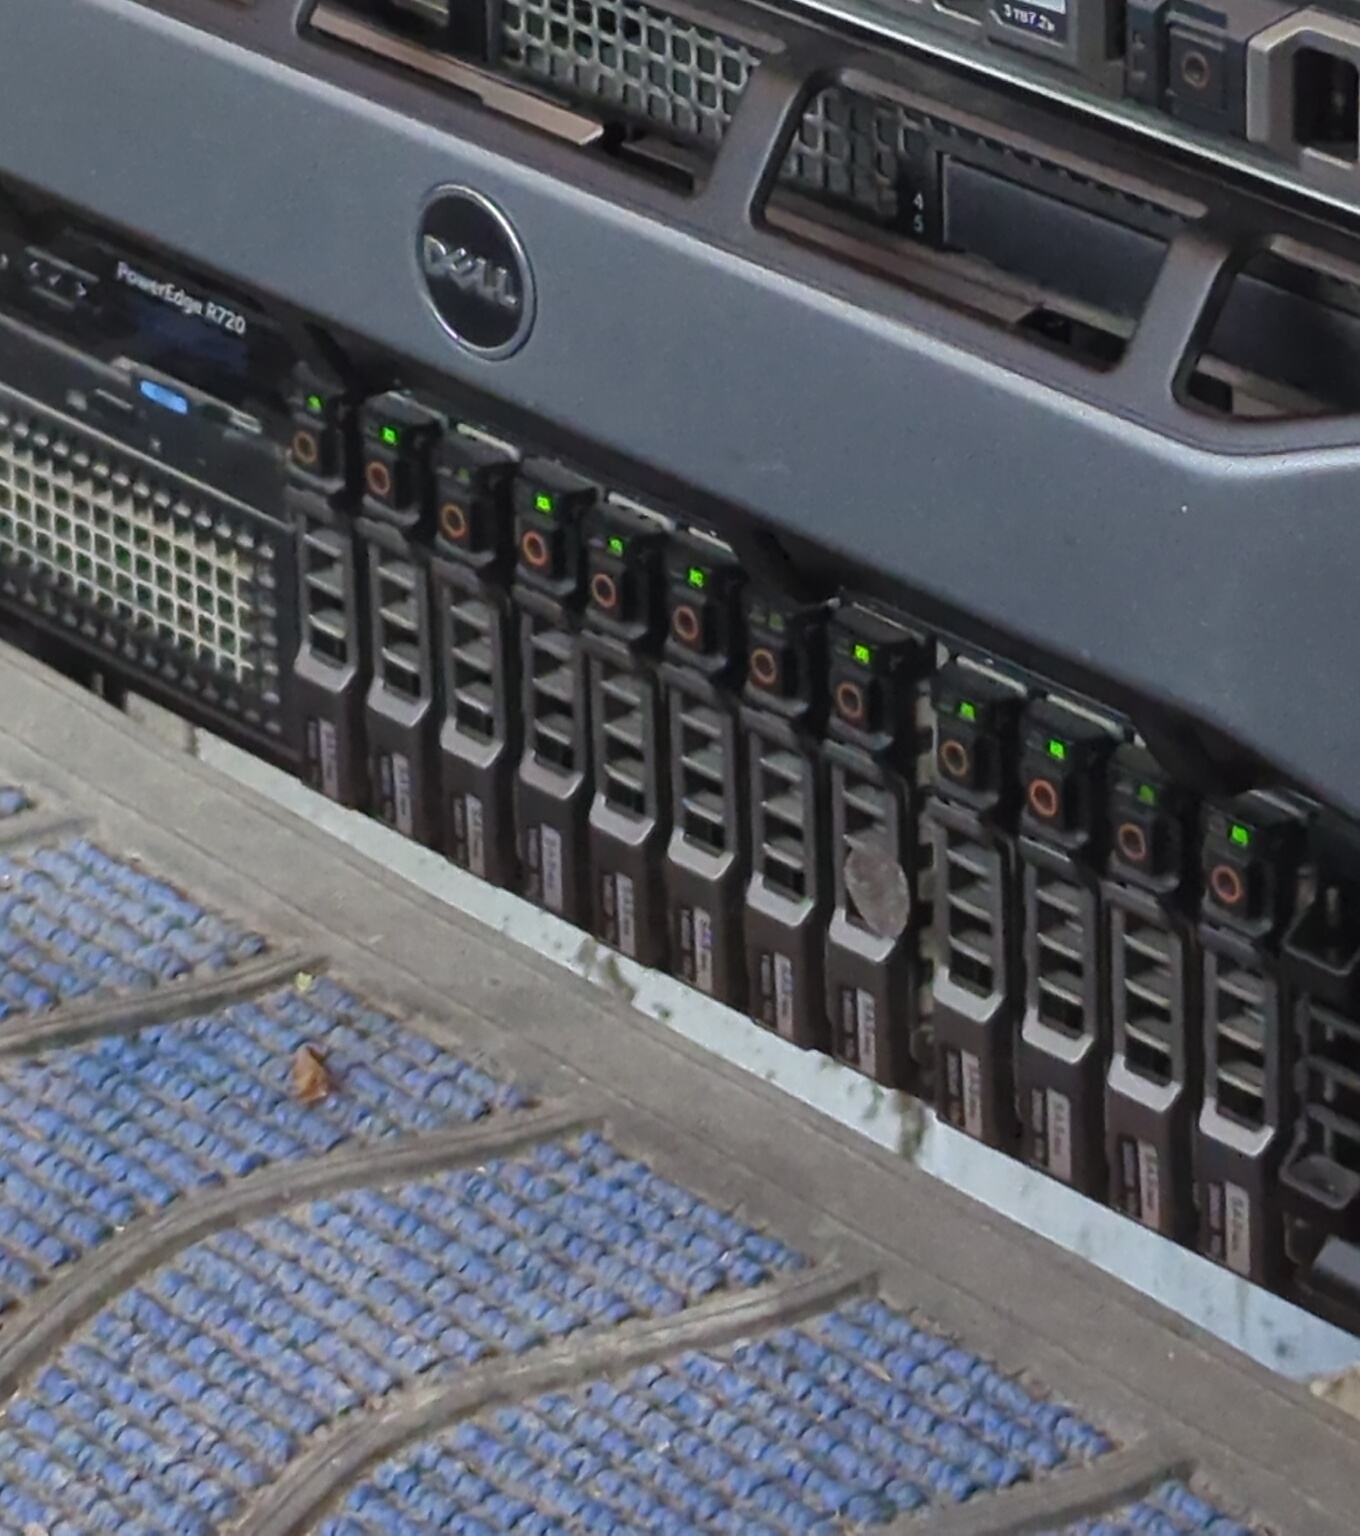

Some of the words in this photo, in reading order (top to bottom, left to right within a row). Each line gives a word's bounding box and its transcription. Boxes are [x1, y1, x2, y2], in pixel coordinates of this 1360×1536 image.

[117, 260, 203, 315] PowerEdge
[205, 301, 246, 335] R720
[423, 234, 518, 309] DELL
